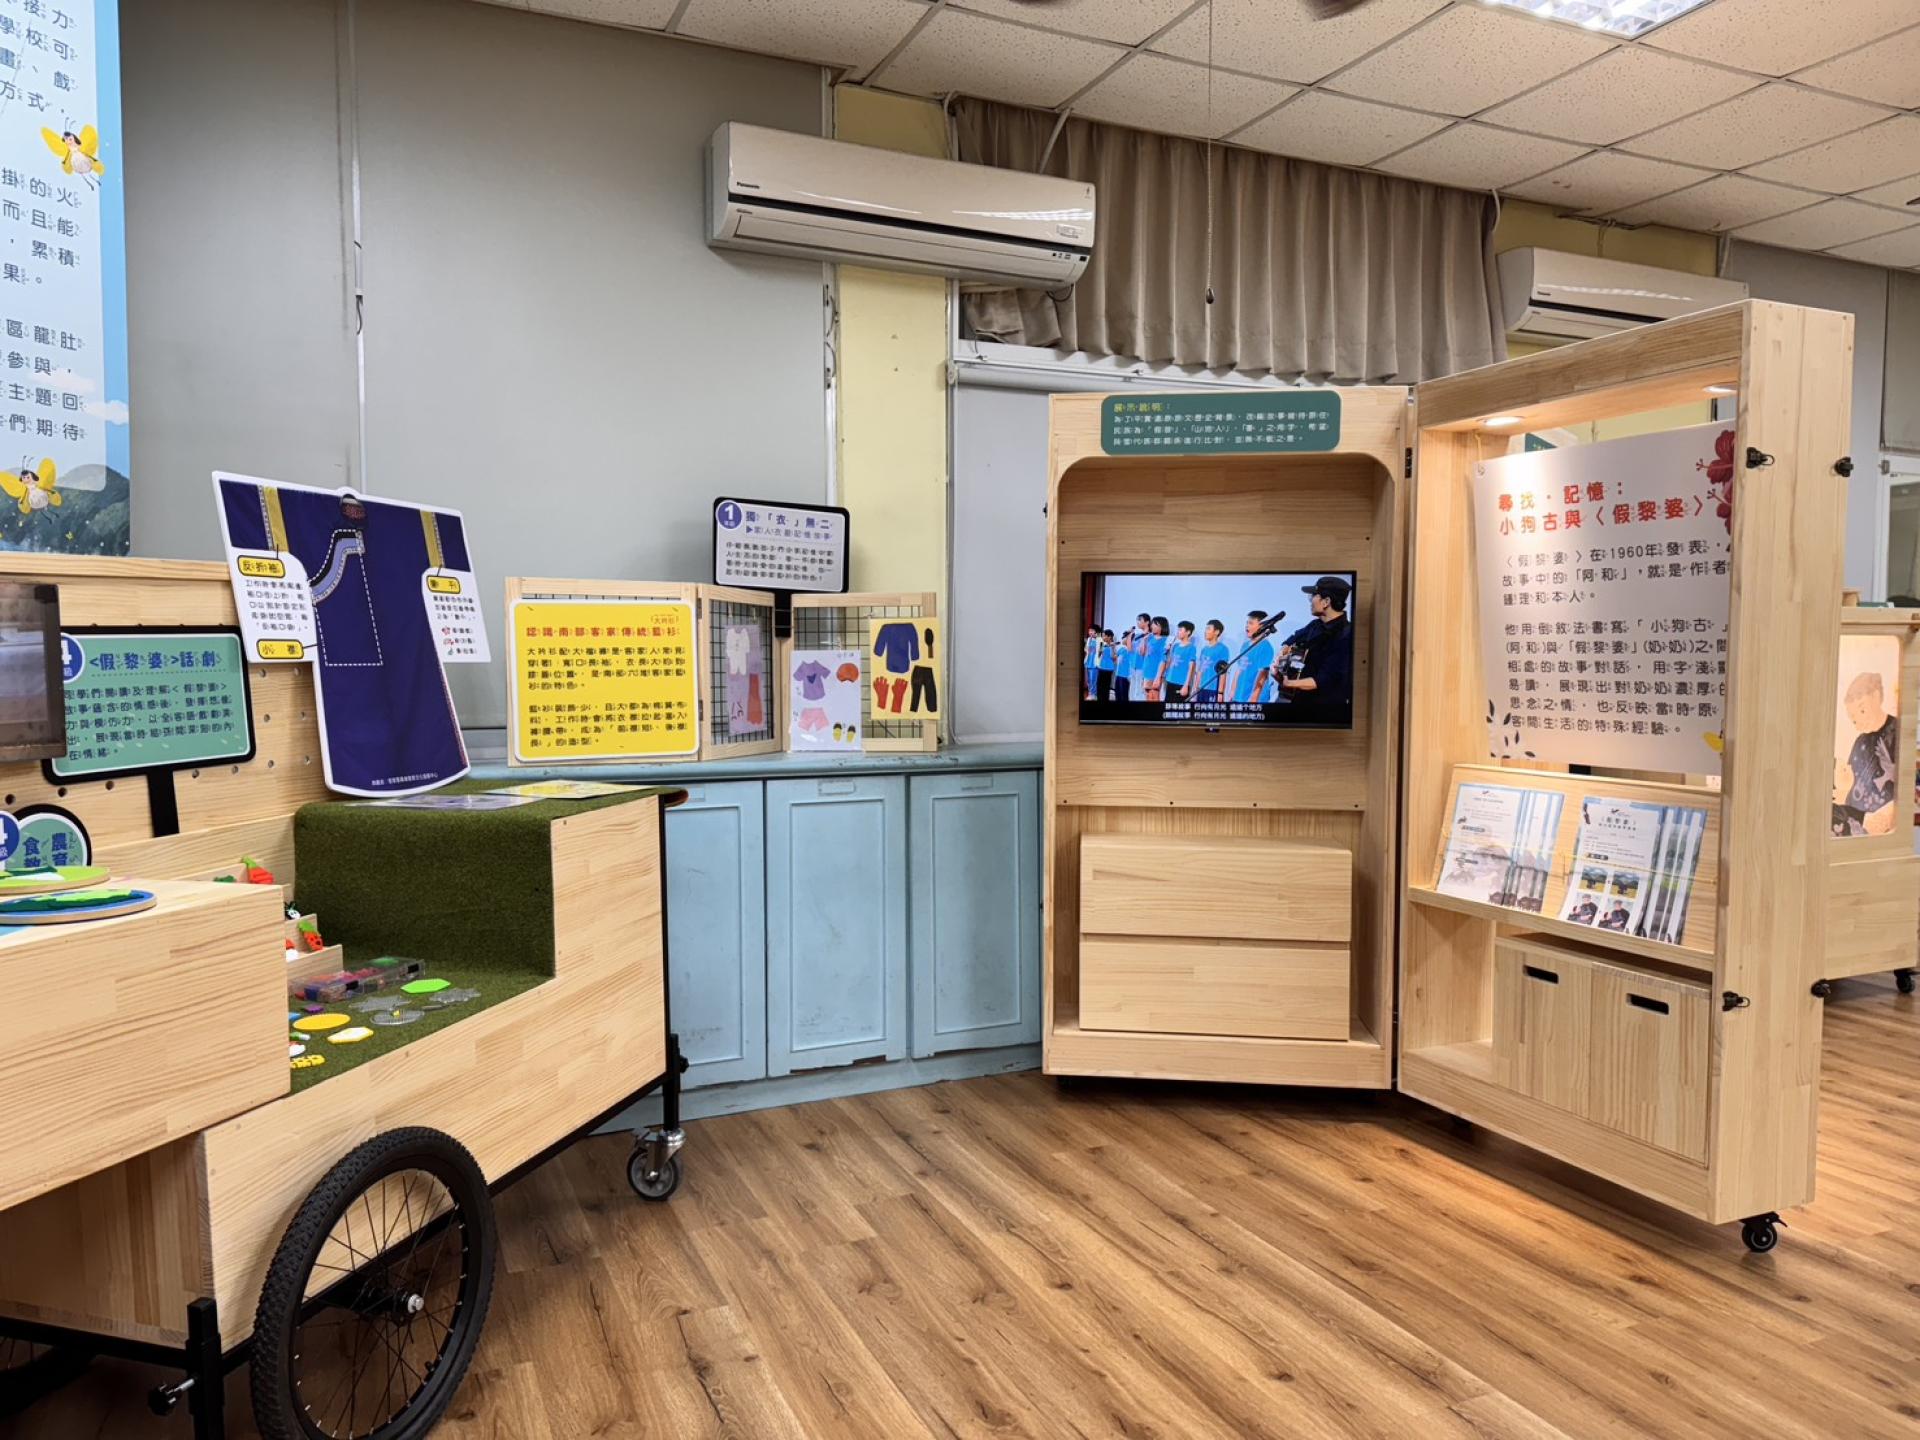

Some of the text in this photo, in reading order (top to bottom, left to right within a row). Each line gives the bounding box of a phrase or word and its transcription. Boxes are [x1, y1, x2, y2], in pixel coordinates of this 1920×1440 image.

[2, 199, 81, 237] 而且能
[3, 263, 43, 284] 果。
[6, 319, 85, 352] 區龍肚
[7, 351, 72, 376] 參與，
[8, 383, 87, 413] 主題回
[8, 414, 88, 442] 們期待
[725, 505, 734, 521] 1
[1499, 495, 1705, 535] 小狗古與〈假黎婆〉
